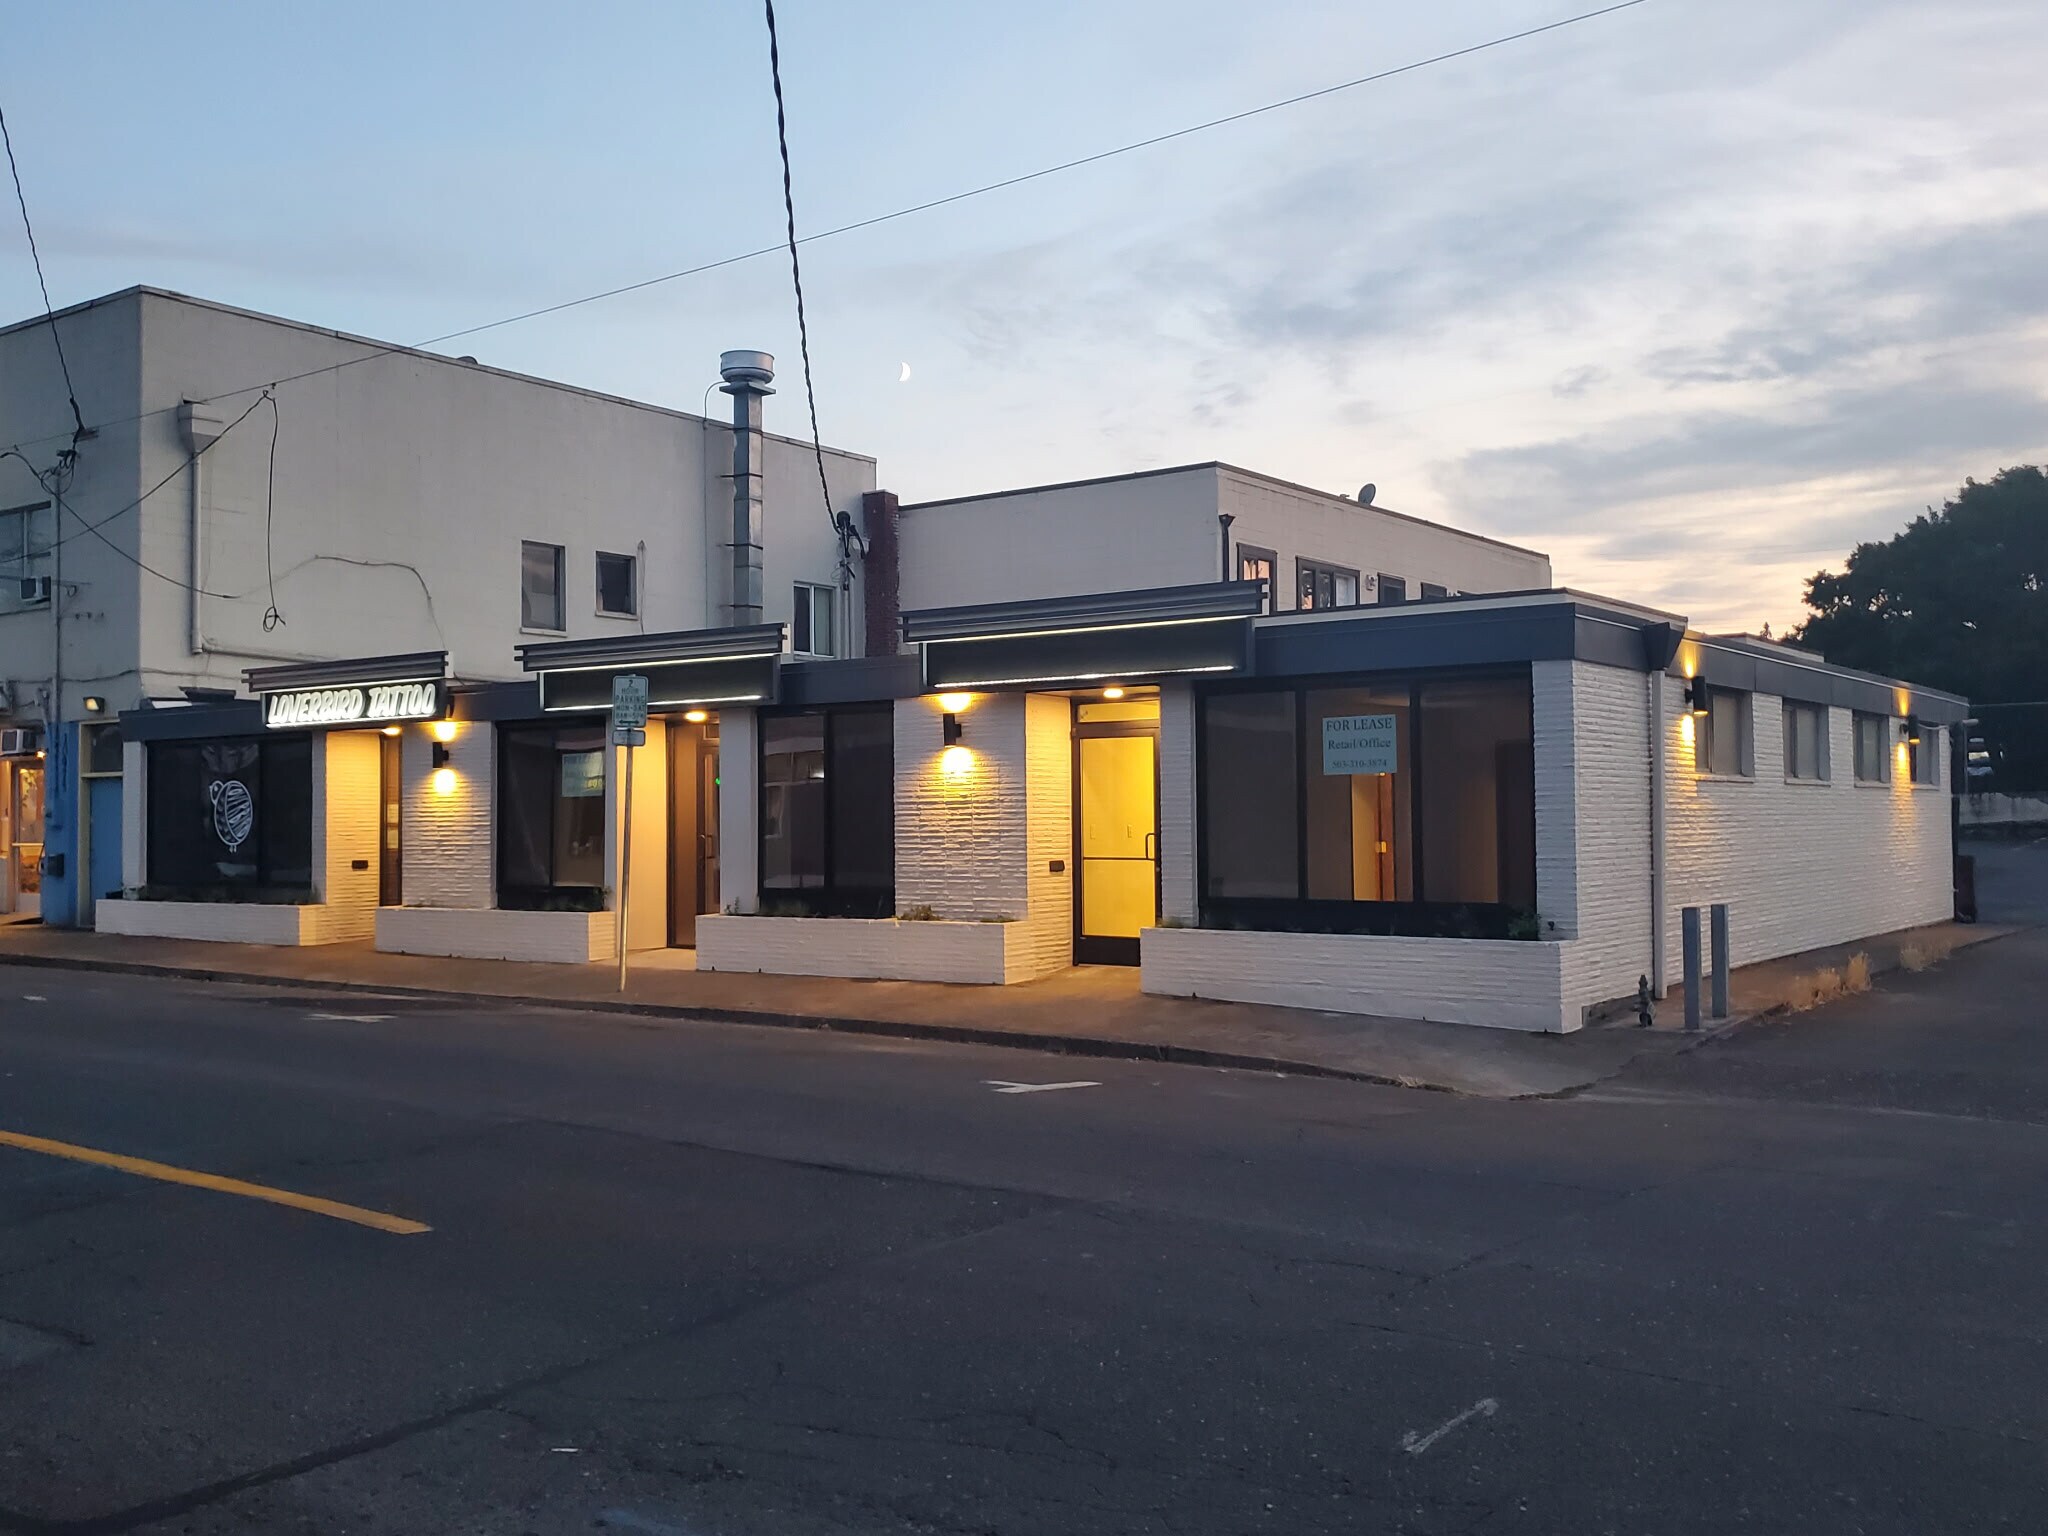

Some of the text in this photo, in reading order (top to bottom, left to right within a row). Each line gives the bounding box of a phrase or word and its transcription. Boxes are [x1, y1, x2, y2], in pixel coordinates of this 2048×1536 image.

[268, 683, 436, 724] LOVERBIRD TATTOO
[616, 694, 645, 704] PARKING
[1326, 717, 1392, 731] FOR LEASE
